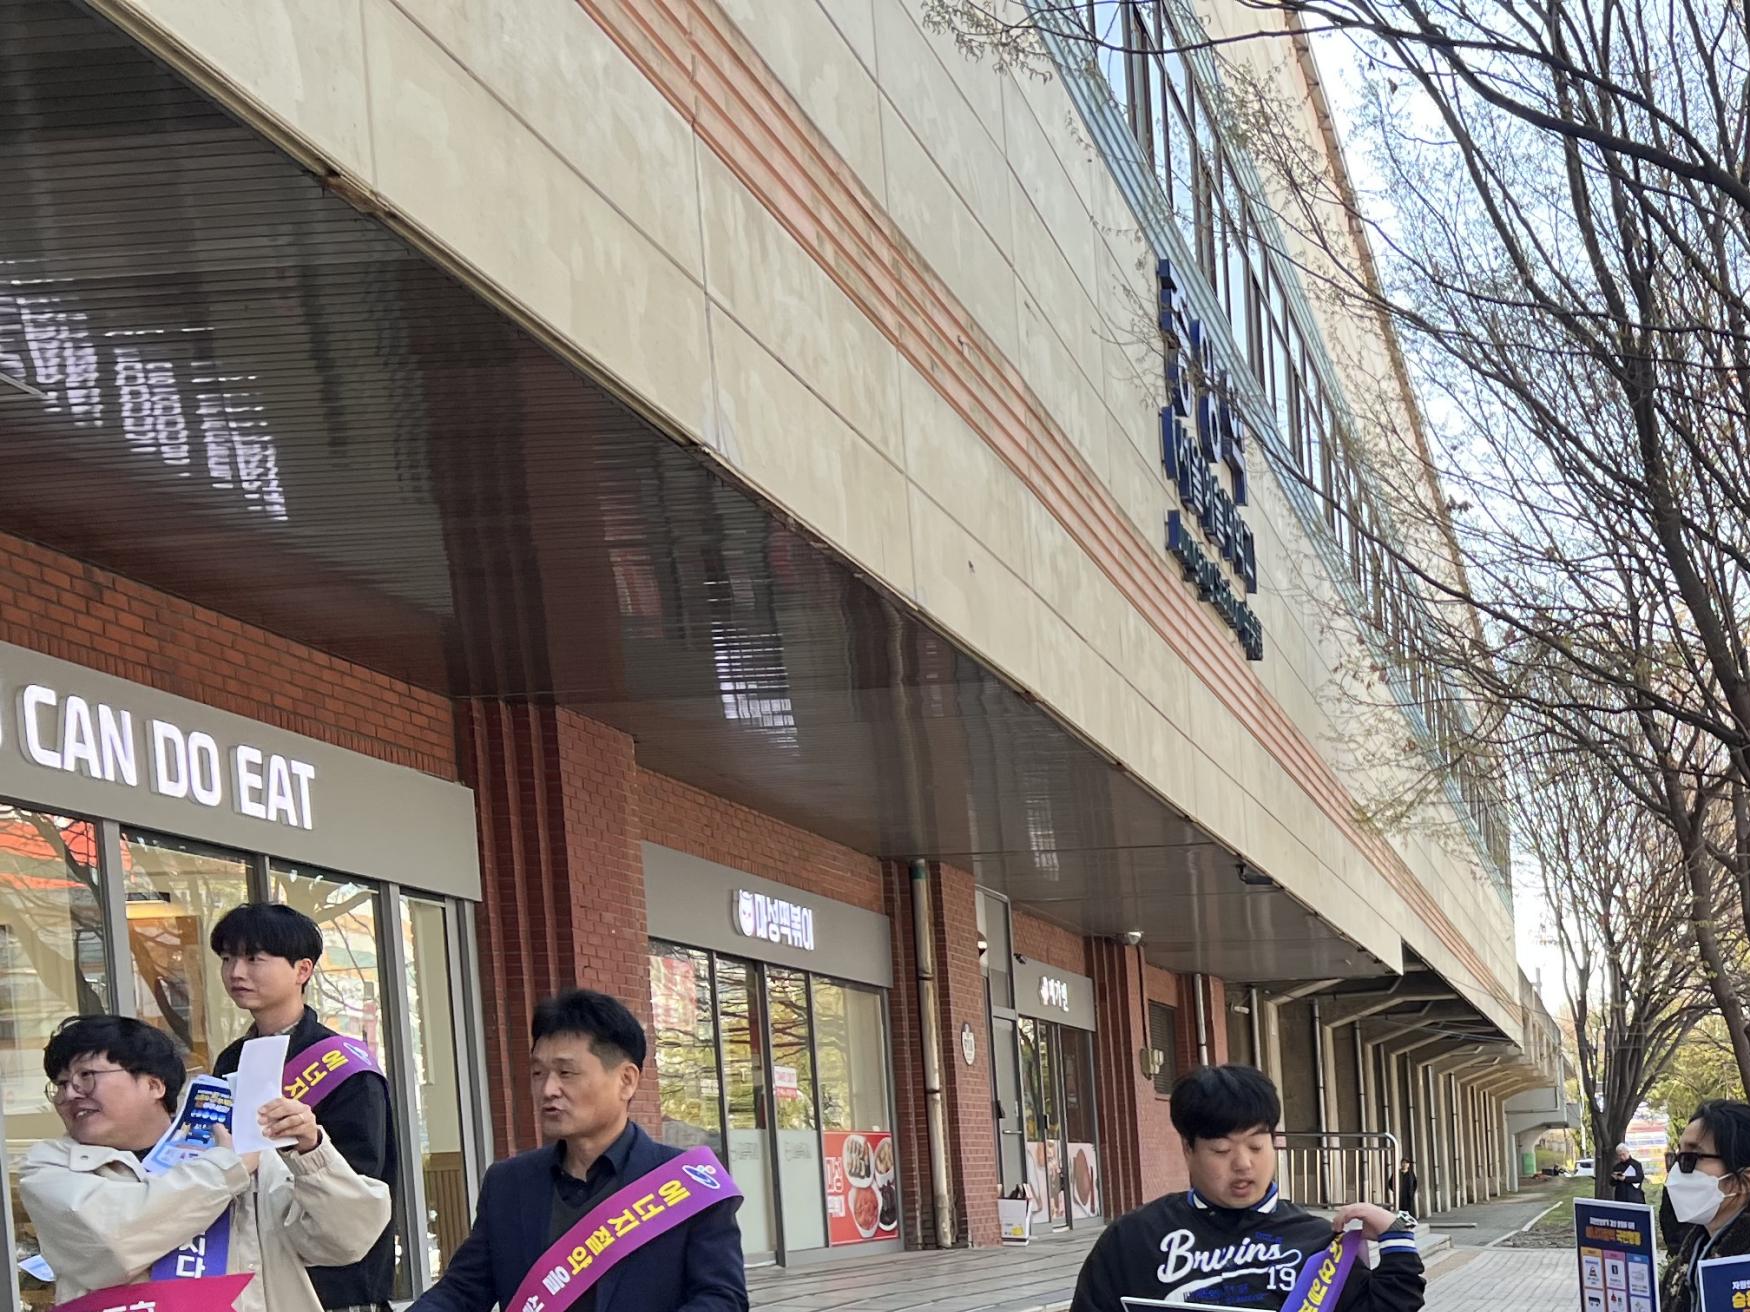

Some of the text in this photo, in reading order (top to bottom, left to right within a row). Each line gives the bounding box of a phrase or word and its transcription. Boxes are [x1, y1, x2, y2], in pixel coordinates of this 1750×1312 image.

[20, 684, 315, 830] CAN DO EAT
[542, 1179, 692, 1296] 에너지절약을
[1157, 1229, 1281, 1283] Bruins
[1267, 1266, 1297, 1291] 19
